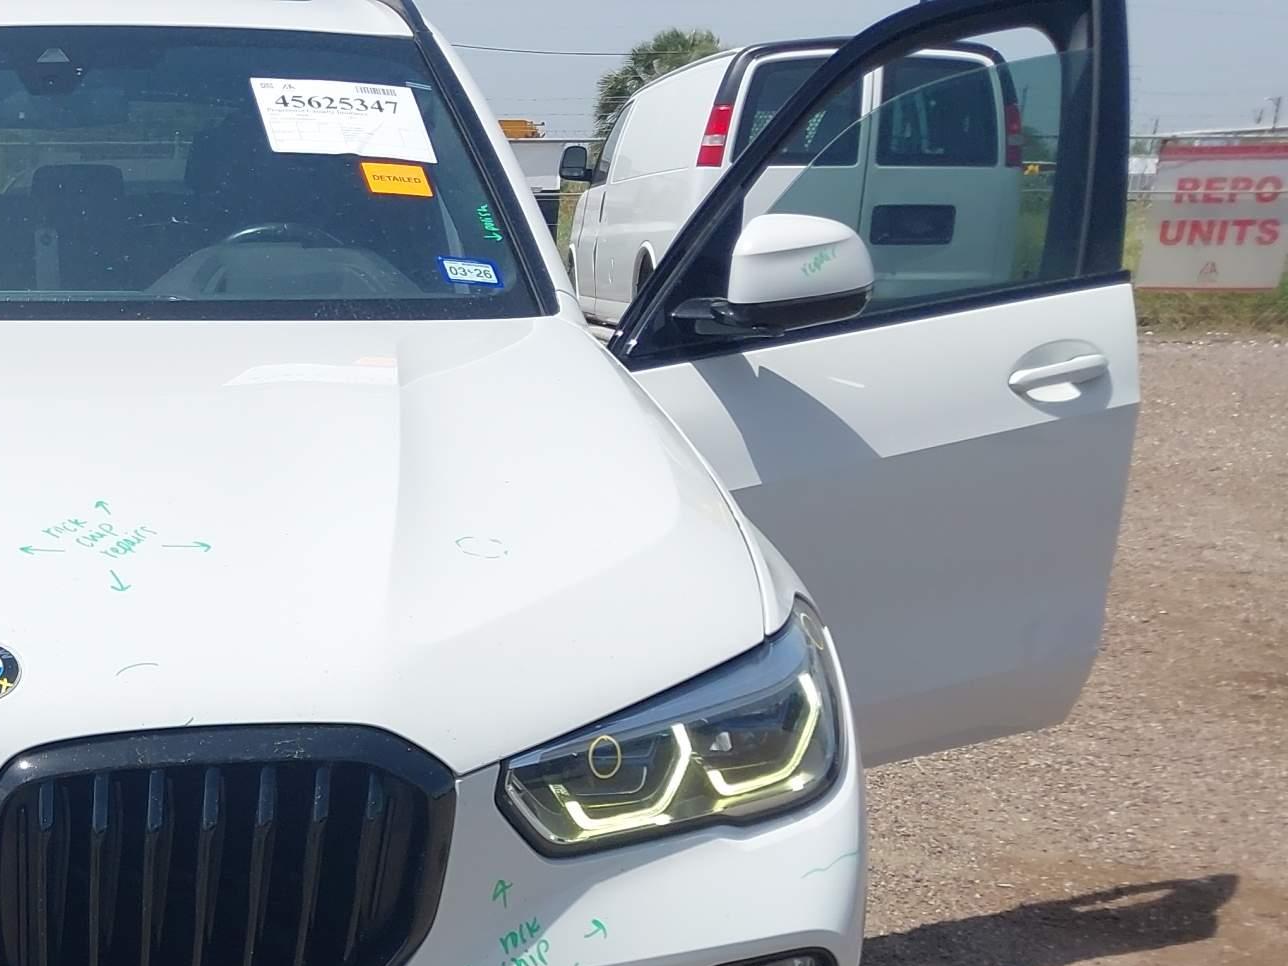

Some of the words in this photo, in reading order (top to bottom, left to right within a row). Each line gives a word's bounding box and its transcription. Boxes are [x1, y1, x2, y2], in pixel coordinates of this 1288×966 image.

[275, 94, 398, 114] 45625347
[372, 174, 422, 184] DETAILED
[1174, 176, 1283, 203] REPO
[1159, 219, 1281, 246] UNITS
[41, 518, 88, 538] rock
[75, 522, 119, 548] chip
[499, 917, 541, 954] rock
